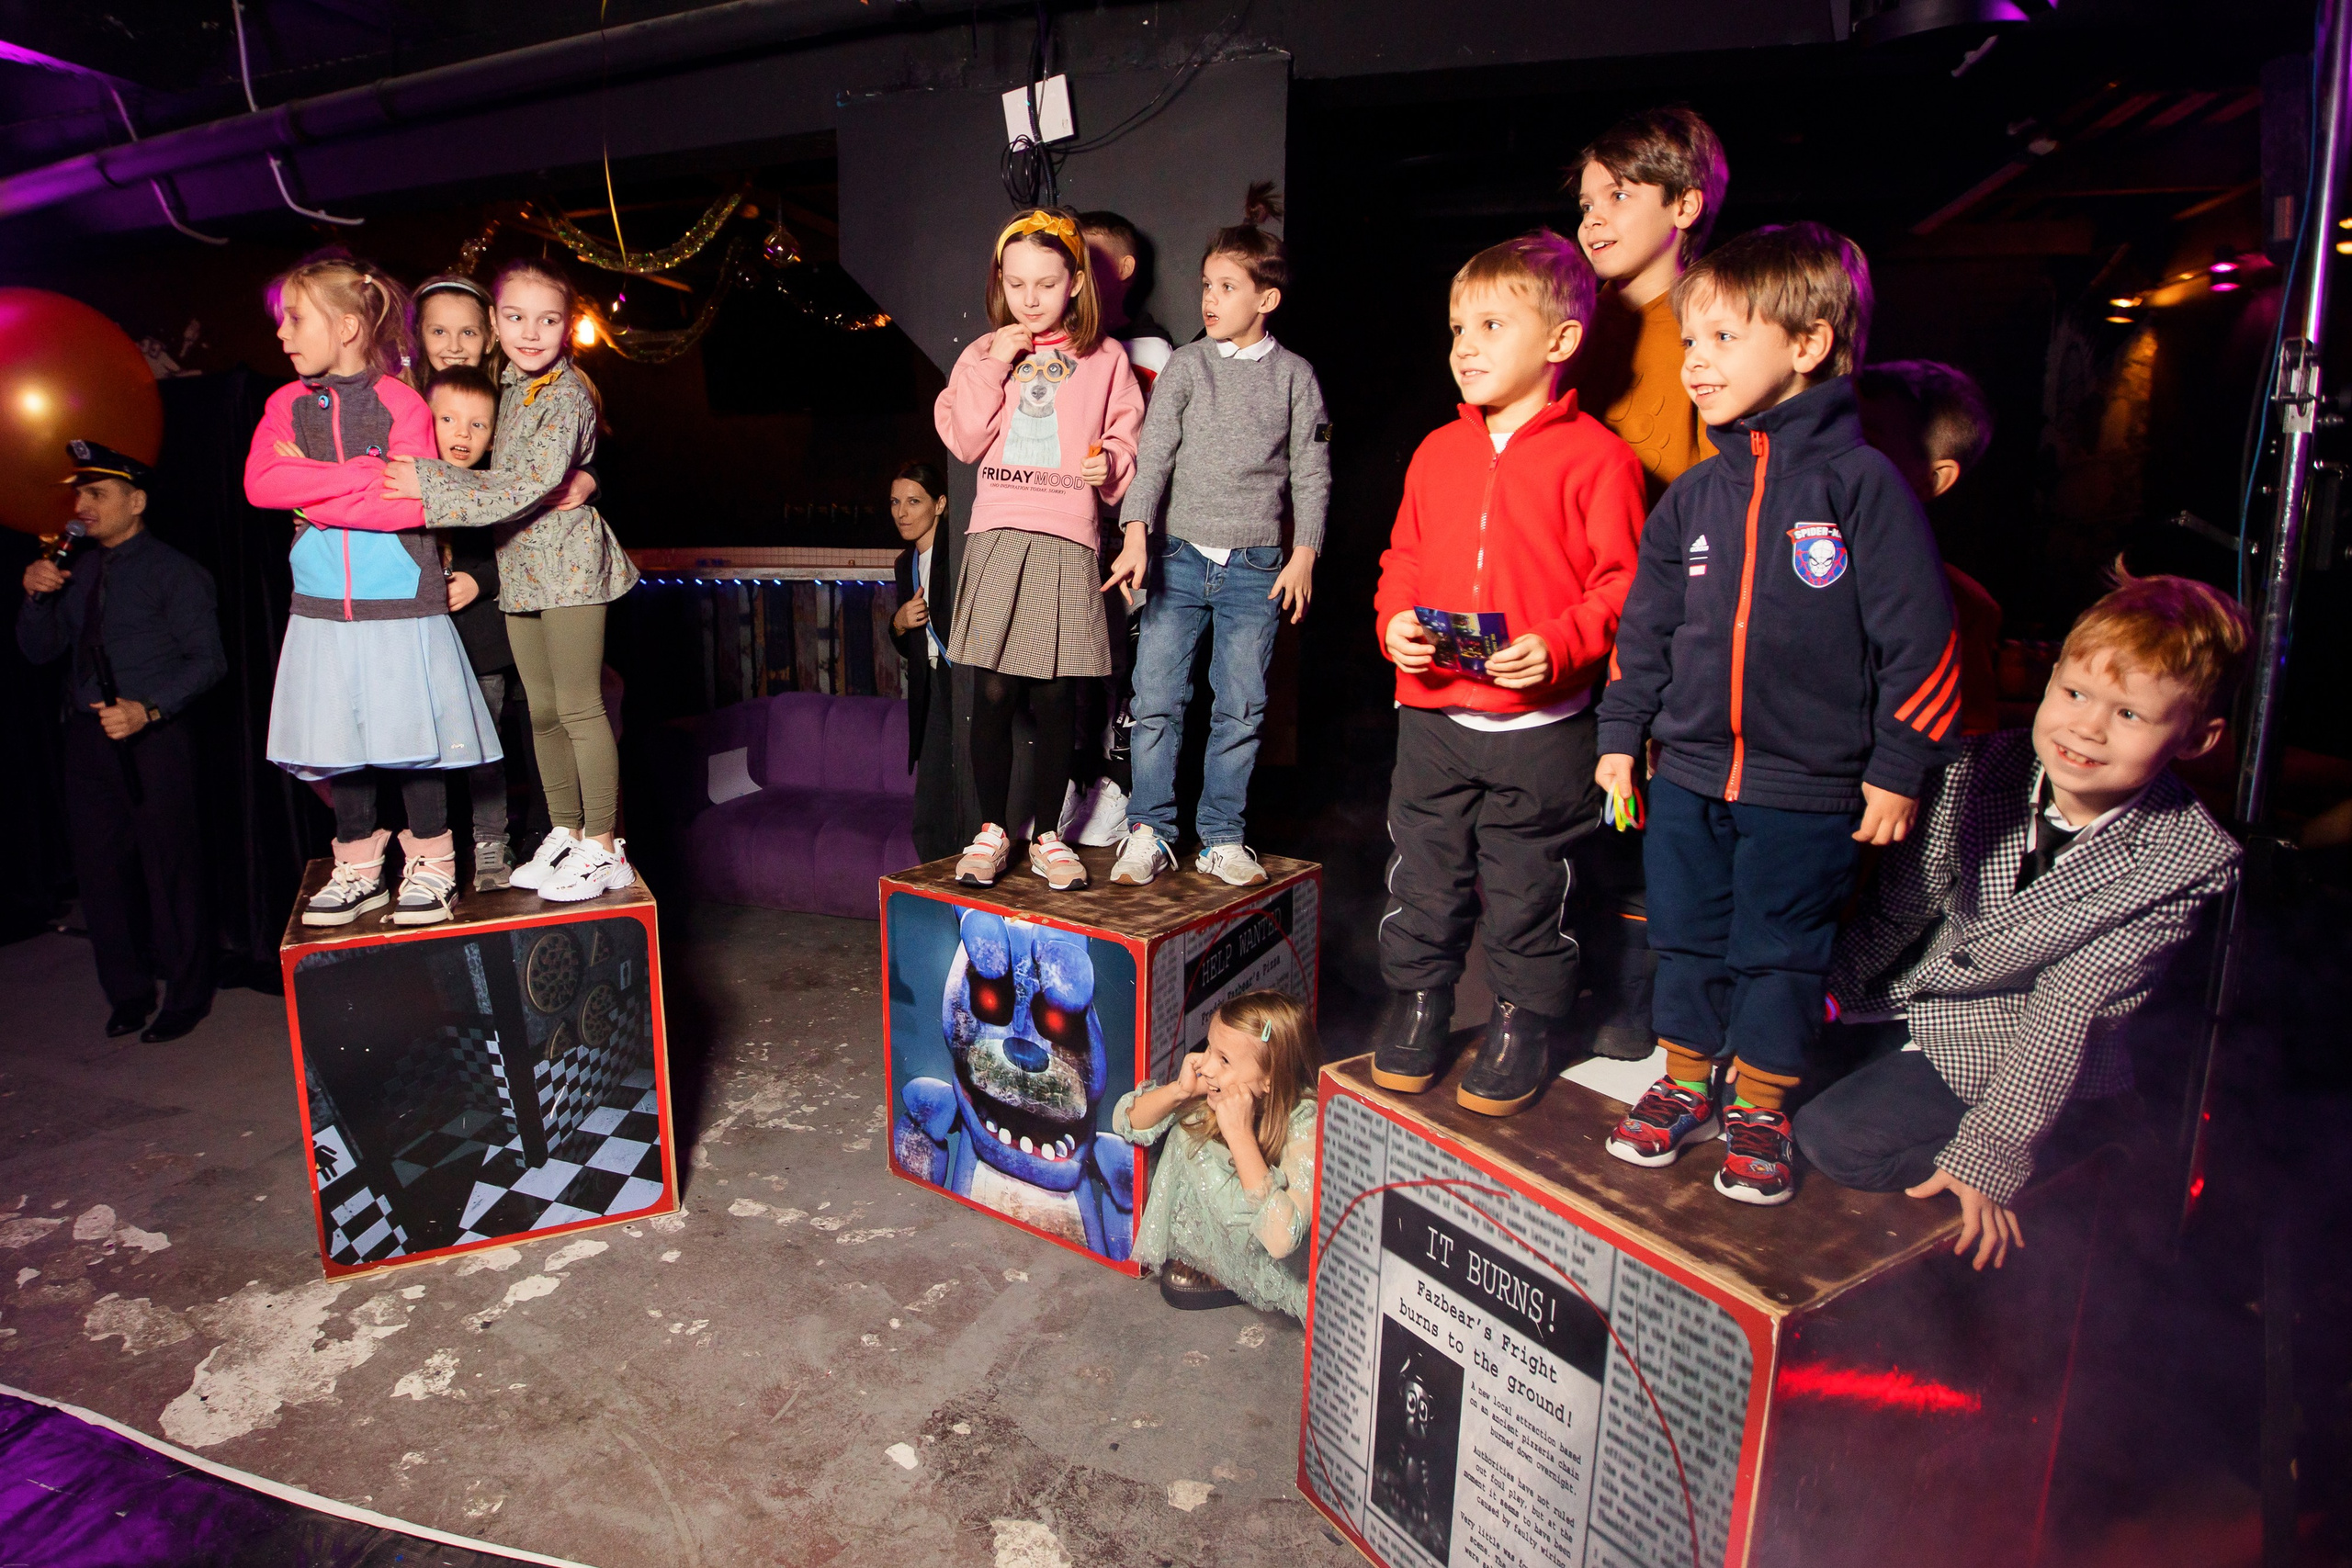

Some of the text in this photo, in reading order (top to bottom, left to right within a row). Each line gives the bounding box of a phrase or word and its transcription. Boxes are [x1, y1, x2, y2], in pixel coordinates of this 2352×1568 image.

[982, 467, 1085, 491] FRIDAY MOOD
[1793, 526, 1842, 540] SPIDER-M
[1202, 944, 1232, 987] HELP
[1238, 907, 1282, 957] WANTED
[1426, 1225, 1453, 1269] IT
[1466, 1249, 1556, 1333] BURNS!
[1399, 1297, 1439, 1337] burns
[1448, 1332, 1464, 1354] to
[1474, 1348, 1498, 1378] the
[1508, 1374, 1572, 1428] ground!
[1417, 1280, 1557, 1384] Fazbear's Fright
[1470, 1397, 1579, 1481] on an ancient pizzeria chain
[1471, 1381, 1581, 1465] A new local attraction based
[1490, 1426, 1577, 1495] burned down overnight.
[1464, 1470, 1571, 1559] moment it seems to have been
[1473, 1446, 1575, 1528] Authorities have not ruled
[1476, 1464, 1573, 1543] out foul play, but at the
[1476, 1495, 1499, 1518] caused
[1502, 1514, 1510, 1528] by
[1514, 1524, 1538, 1549] faulty
[1461, 1511, 1515, 1562] Very little was
